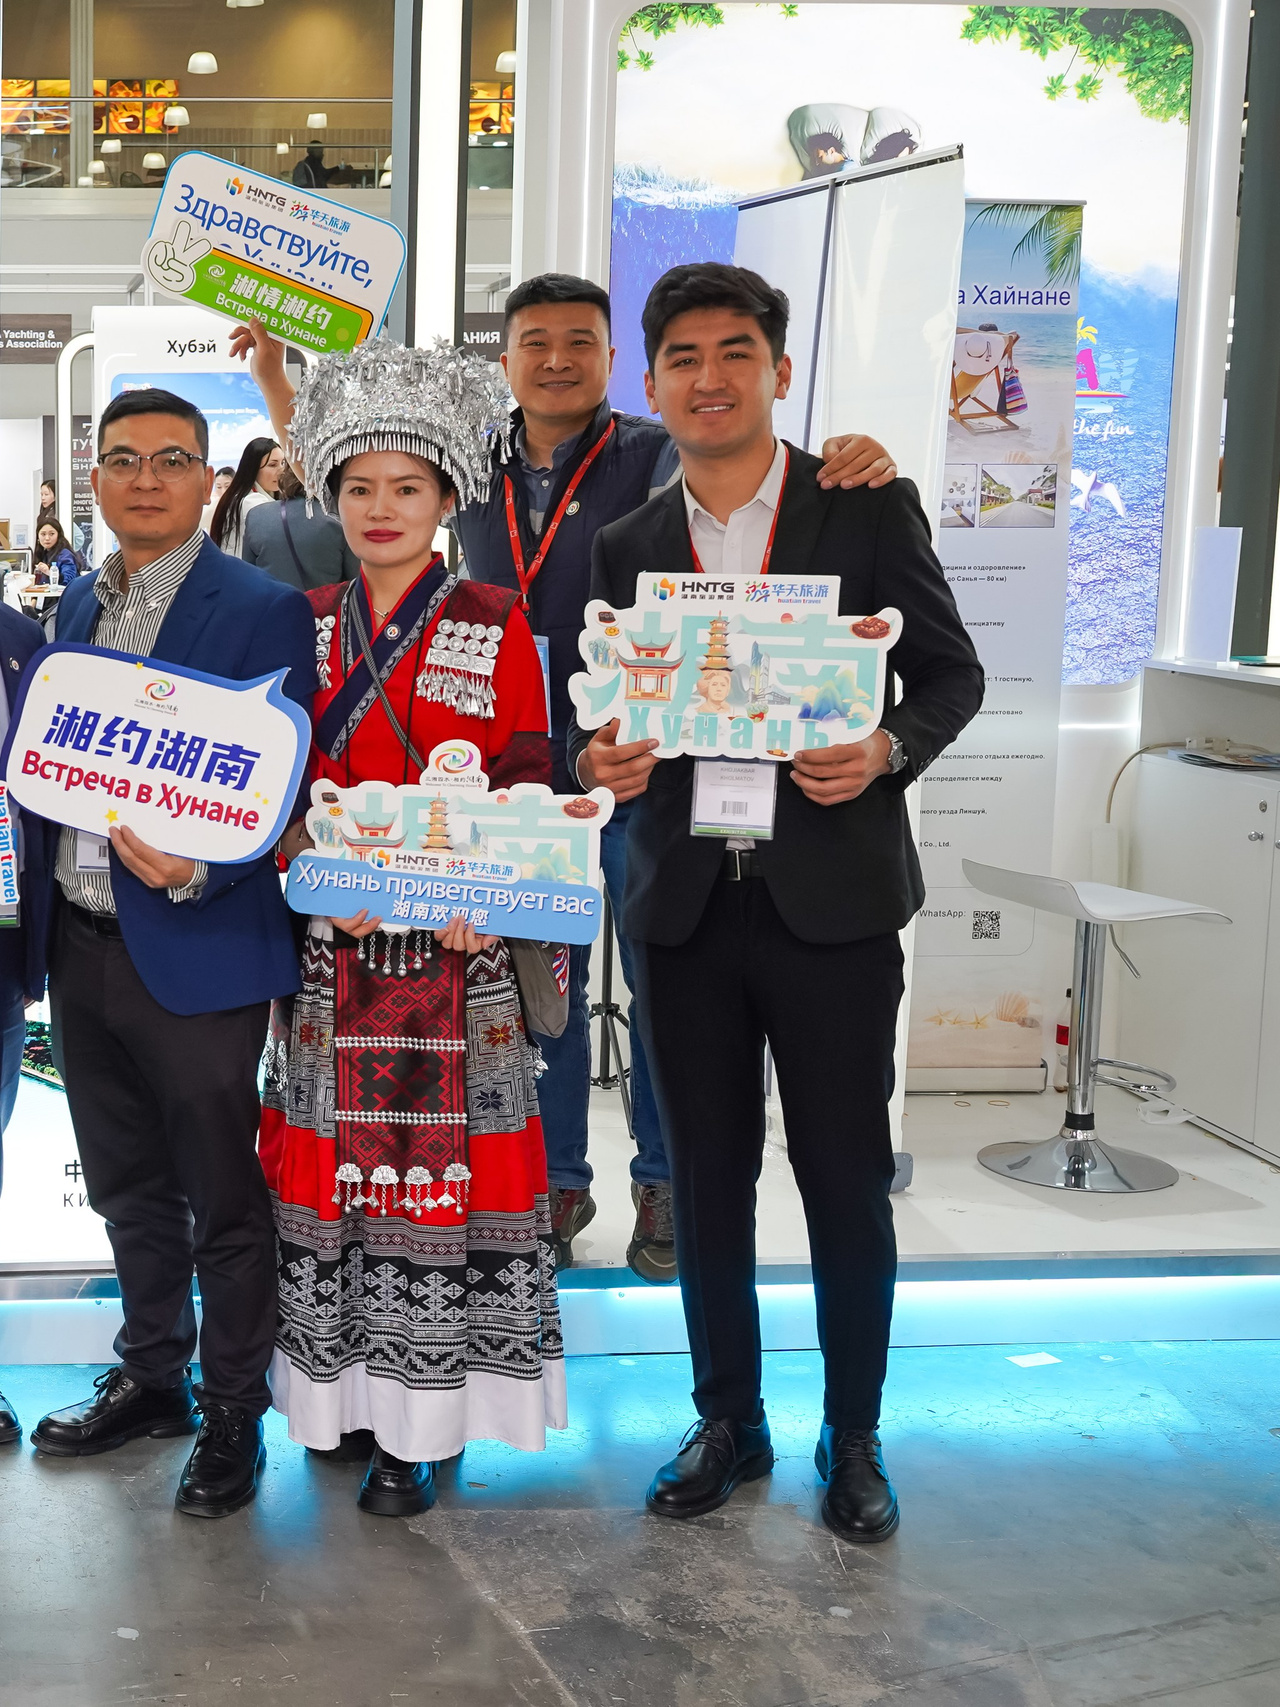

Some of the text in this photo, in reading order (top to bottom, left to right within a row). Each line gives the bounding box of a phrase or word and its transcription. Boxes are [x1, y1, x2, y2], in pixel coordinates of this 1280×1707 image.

[247, 185, 287, 207] HNTG
[310, 209, 351, 233] 华天旅游
[174, 183, 373, 289] Здравствуйте,
[229, 272, 333, 331] 湘情湘约
[972, 284, 1071, 307] Хайнане
[215, 291, 328, 349] Встреча в Хунане
[3, 330, 46, 341] Yachting
[47, 330, 56, 339] &
[6, 340, 63, 349] Association
[167, 339, 218, 358] Хубэй
[681, 581, 735, 593] HNTG
[772, 583, 829, 598] 华天旅游
[627, 706, 829, 750] Хунань
[42, 703, 261, 791] 湘约湖南
[21, 750, 260, 831] Встреча в Хунане
[395, 854, 440, 867] HNTG
[467, 861, 514, 877] 华天旅游
[0, 853, 18, 903] travel
[296, 861, 596, 916] Хунань приветствует вас
[391, 900, 490, 927] 湖南欢迎您
[919, 909, 966, 918] WhatsApp:
